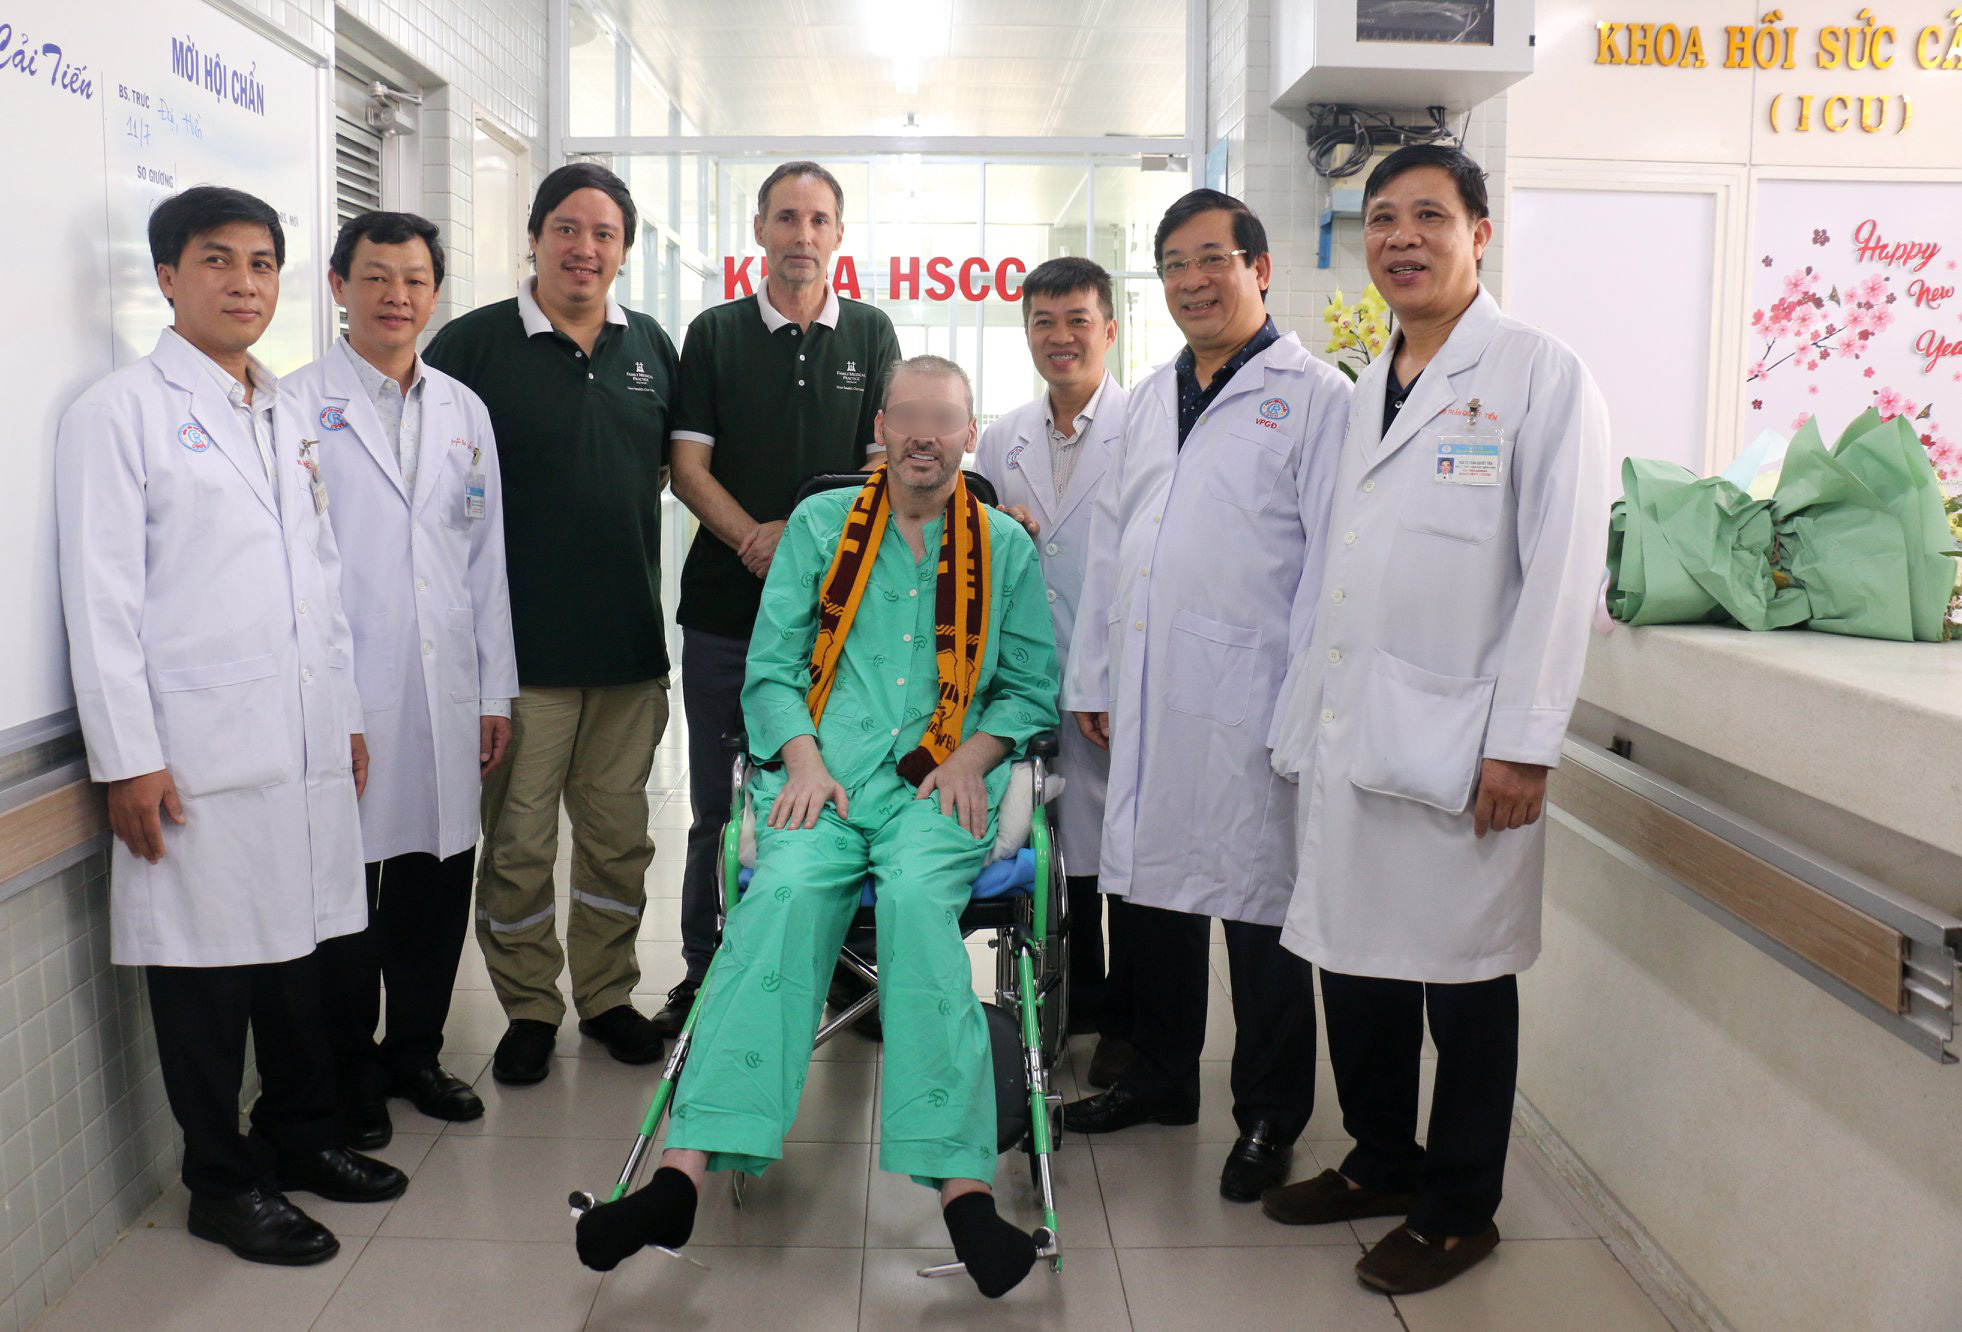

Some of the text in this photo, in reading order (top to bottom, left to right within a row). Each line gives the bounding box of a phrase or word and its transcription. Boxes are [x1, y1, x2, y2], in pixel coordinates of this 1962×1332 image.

[1595, 20, 1708, 68] KHOA
[1723, 9, 1799, 70] HỒI
[1816, 8, 1896, 70] SỨC
[42, 43, 94, 100] Tiến
[172, 34, 200, 86] MỜI
[204, 53, 227, 104] HỘI
[1854, 218, 1943, 273] Happy
[724, 256, 1027, 302] KA HSCC
[1907, 278, 1955, 310] New
